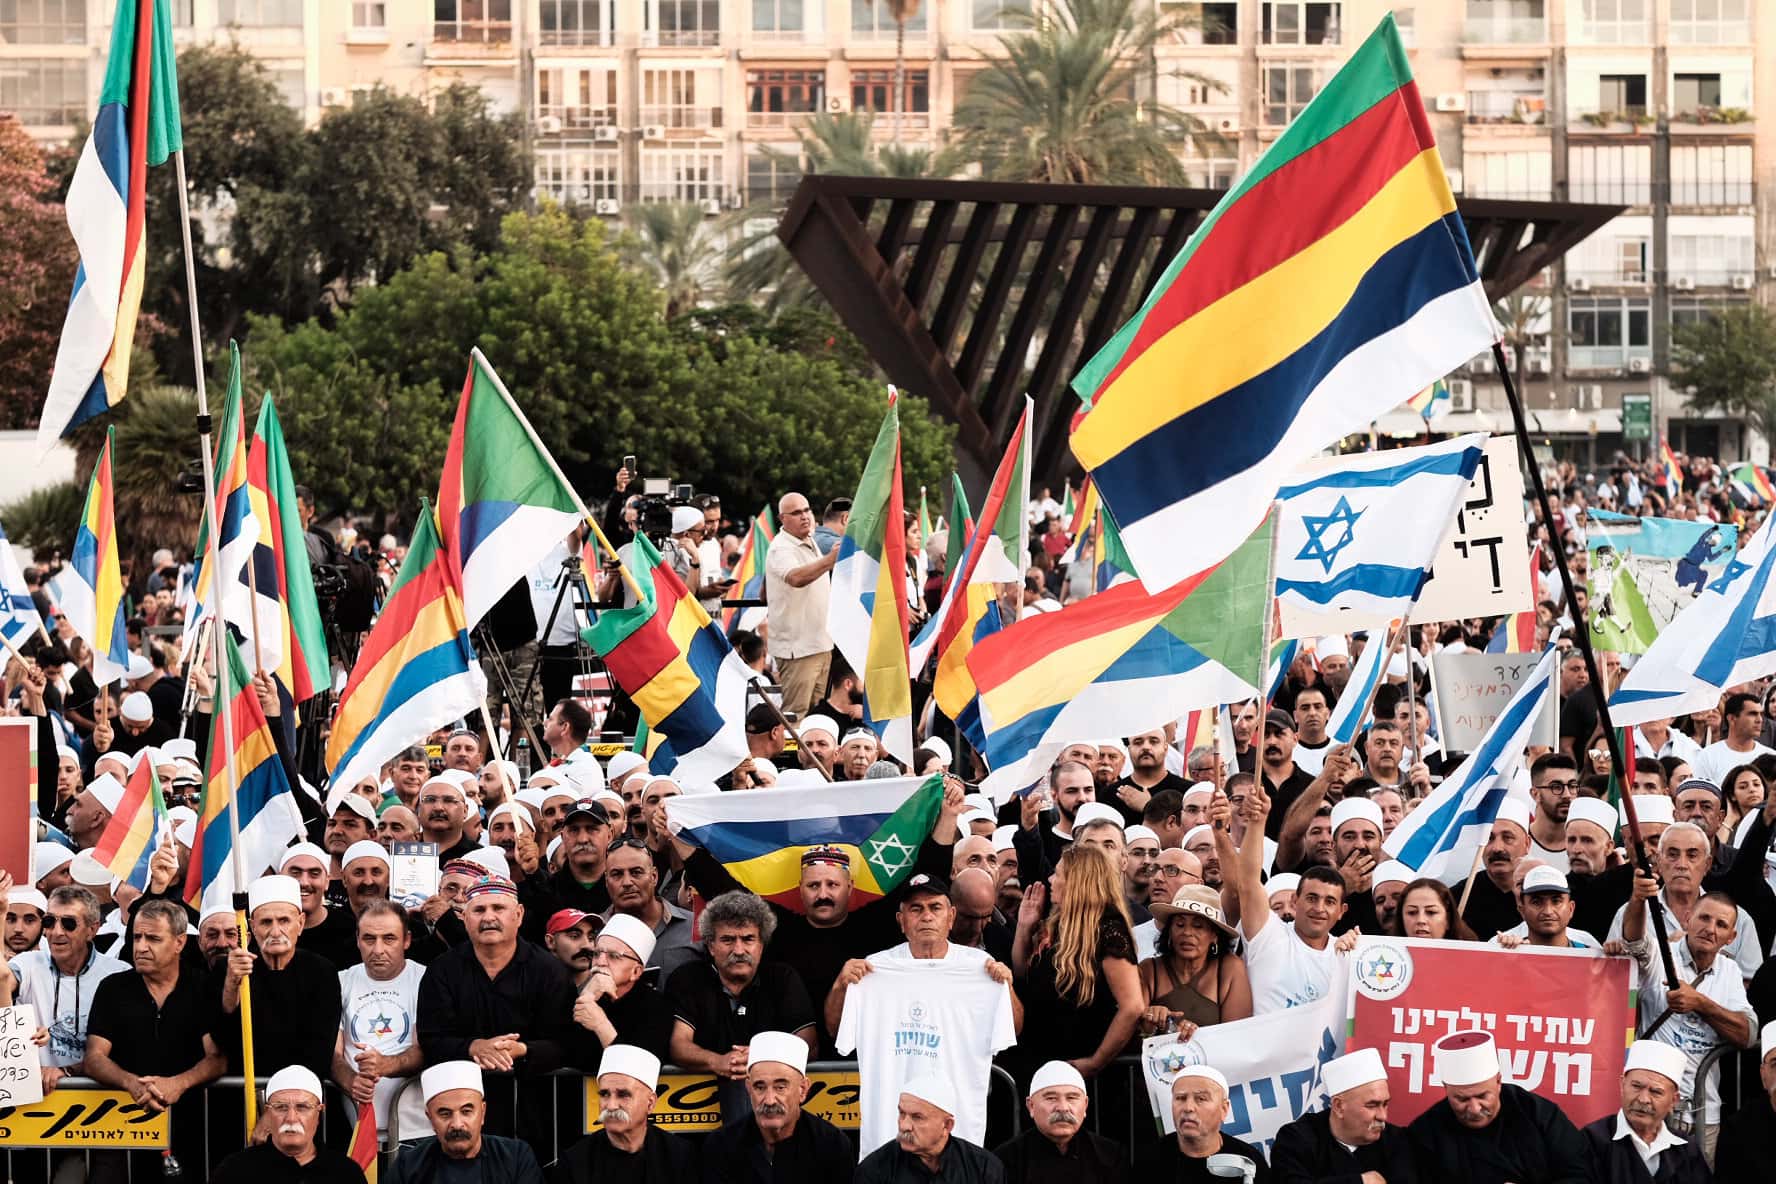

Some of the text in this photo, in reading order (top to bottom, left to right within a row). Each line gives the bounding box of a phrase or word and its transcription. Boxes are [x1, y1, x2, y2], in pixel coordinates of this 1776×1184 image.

[1176, 899, 1219, 921] CCI
[1392, 1006, 1595, 1045] עתיד ילדינו
[895, 1031, 941, 1048] שוויון
[1388, 1041, 1593, 1096] משף
[838, 1111, 861, 1121] יוד
[64, 1129, 160, 1140] ציוד לארועים
